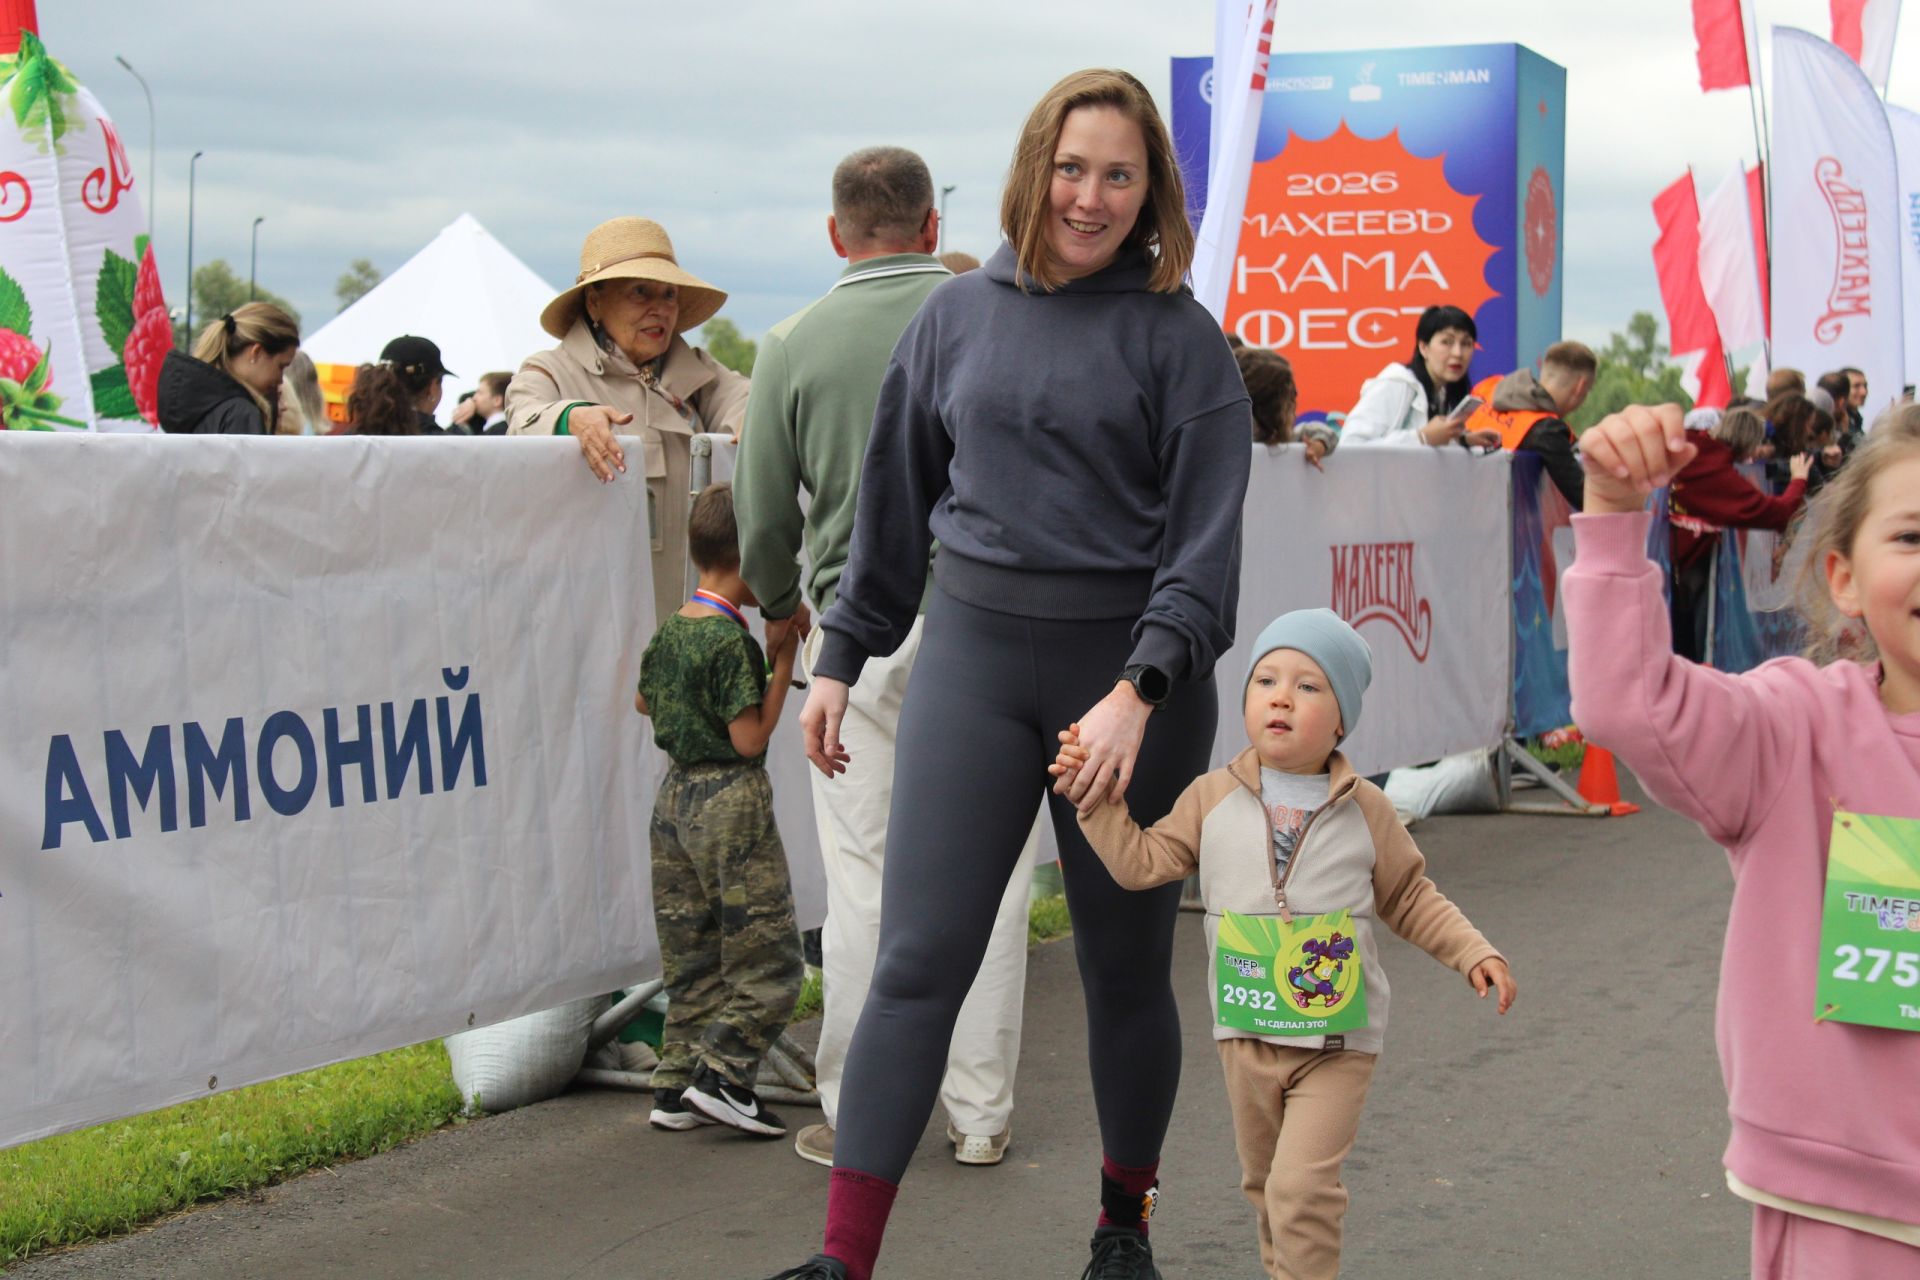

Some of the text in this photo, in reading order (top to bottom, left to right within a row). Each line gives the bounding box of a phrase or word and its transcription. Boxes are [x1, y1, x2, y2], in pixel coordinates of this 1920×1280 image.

[1286, 171, 1399, 196] 2026
[1237, 251, 1450, 294] КАМА
[41, 666, 487, 850] АММОНИЙ
[1223, 984, 1276, 1010] 2932
[1254, 1018, 1328, 1029] ТЫ СДЕЛАЛ ЭТО!
